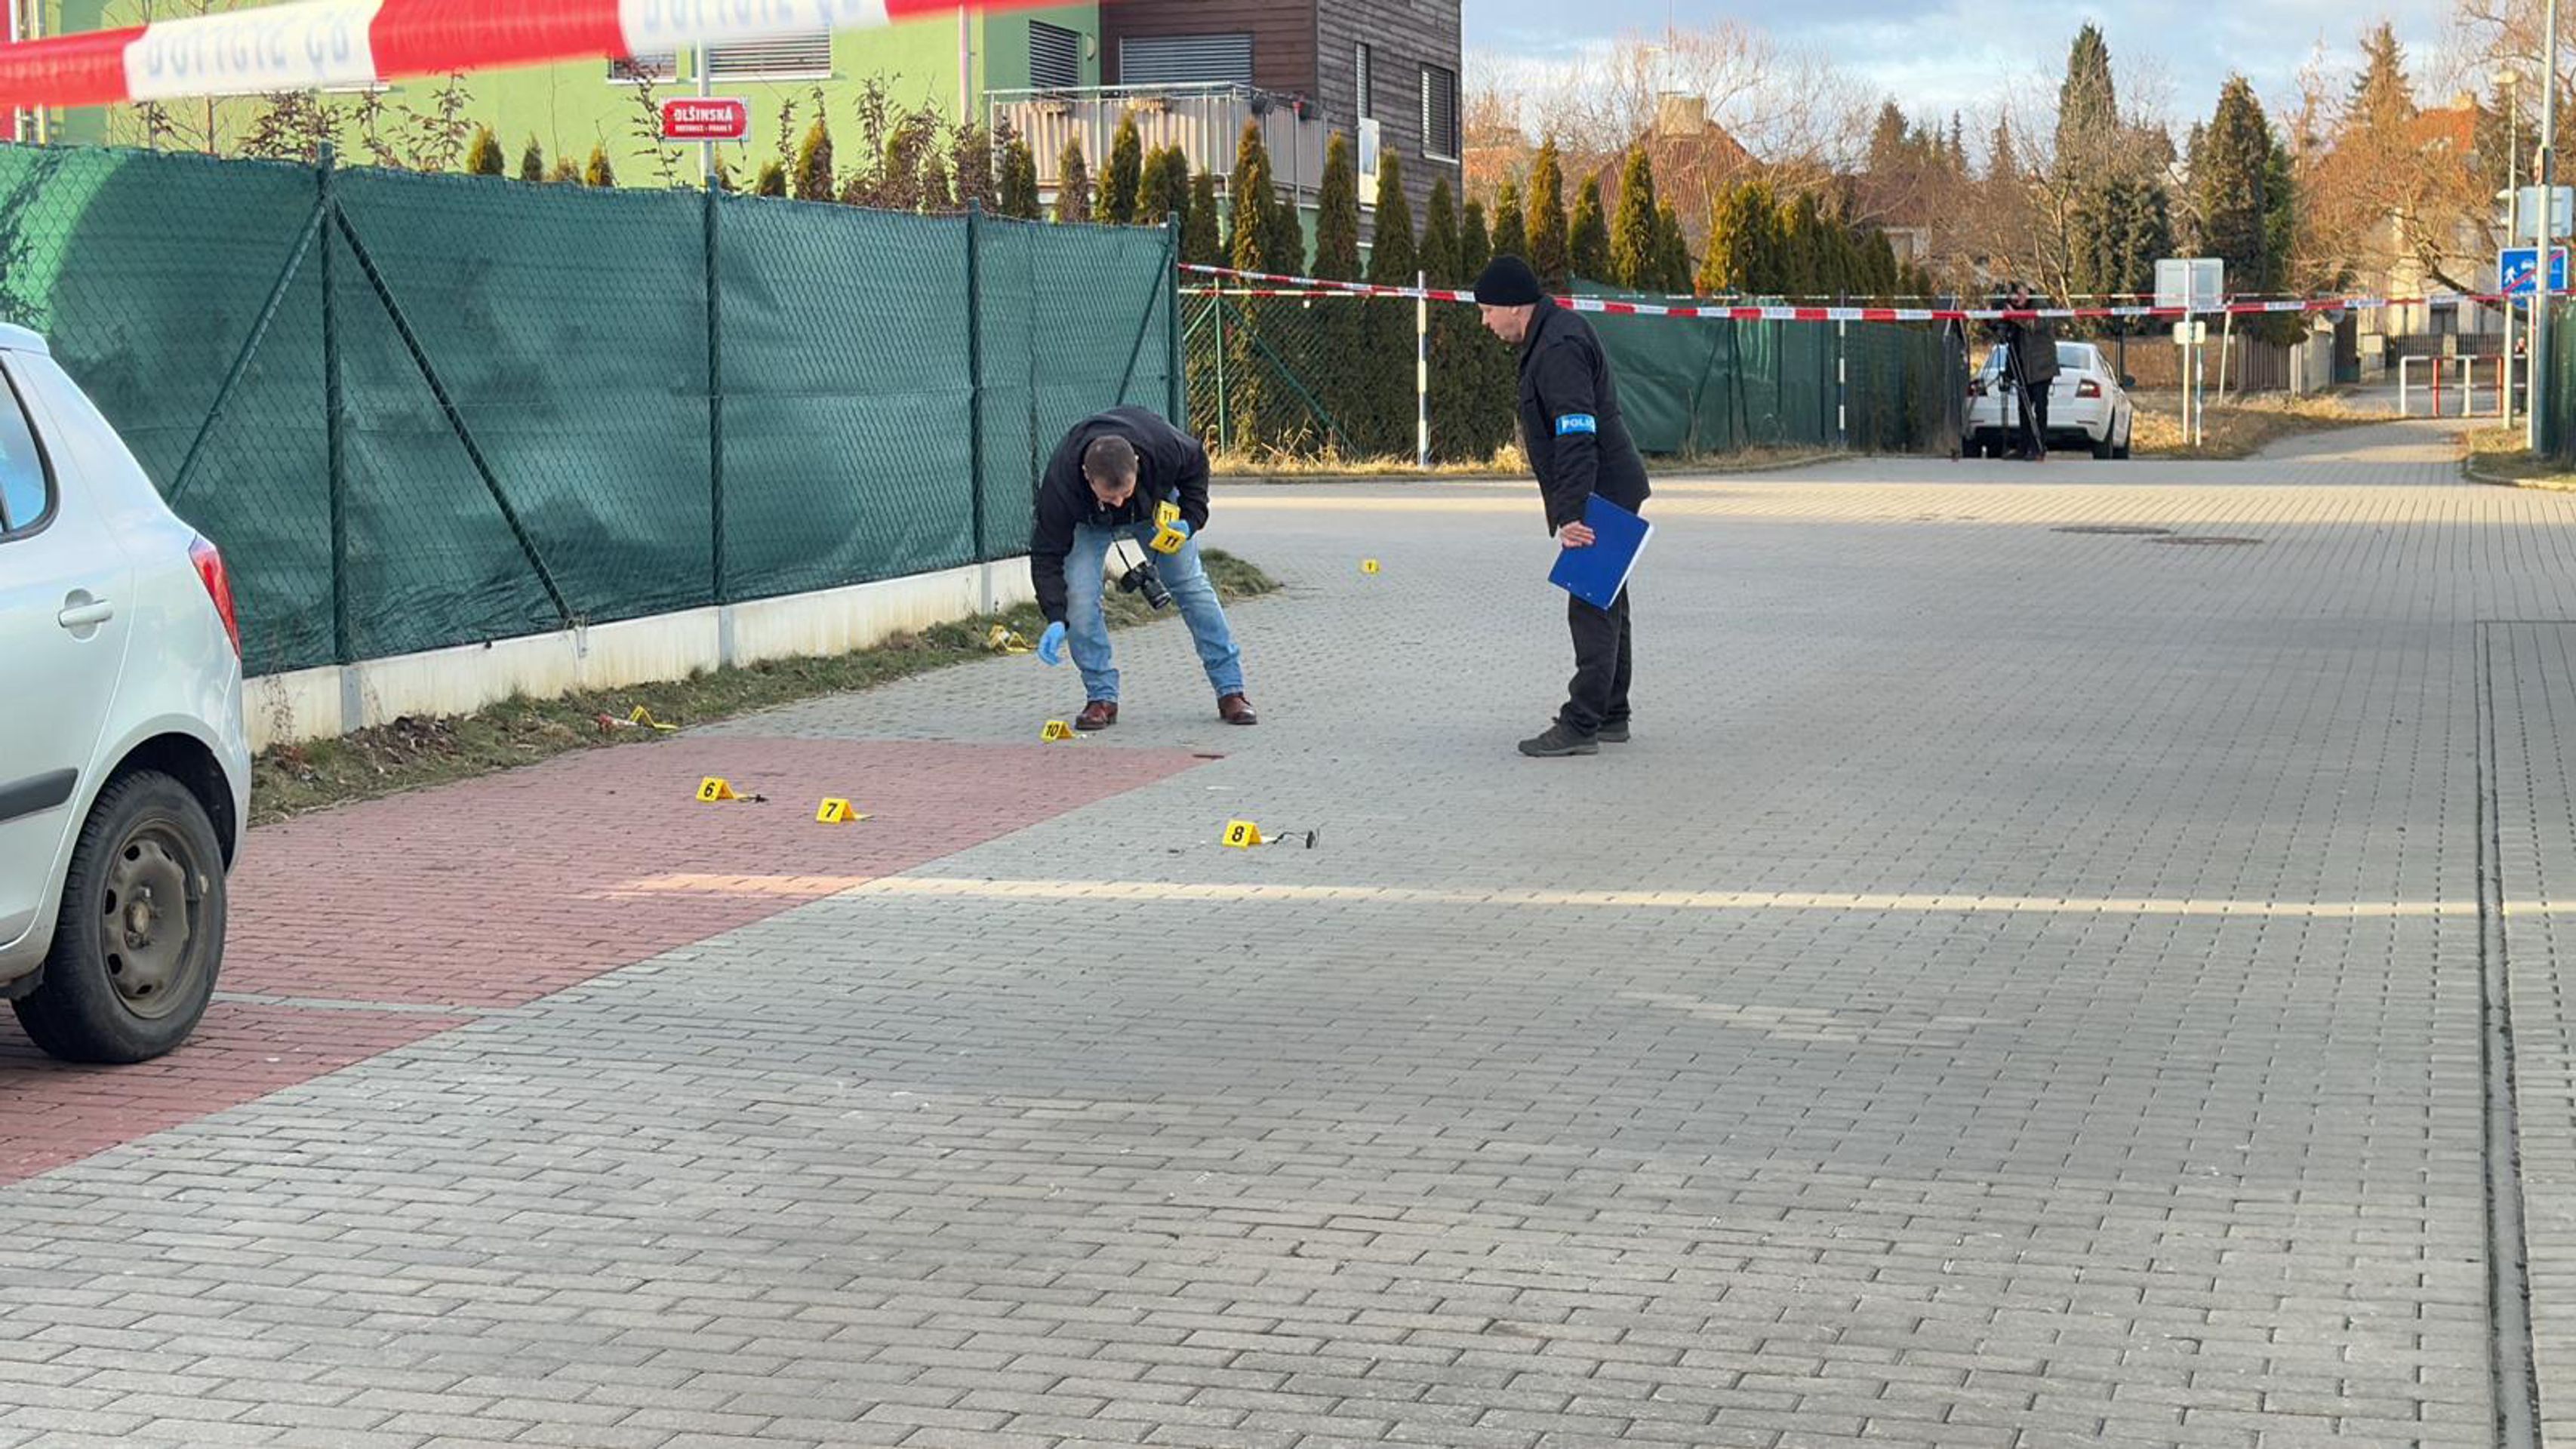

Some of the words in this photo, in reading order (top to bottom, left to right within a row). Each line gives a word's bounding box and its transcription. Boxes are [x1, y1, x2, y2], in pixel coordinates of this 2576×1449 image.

[674, 105, 733, 122] OLŠINSKÁ
[1045, 723, 1060, 737] 10
[703, 782, 716, 798] 6
[826, 801, 838, 818] 7
[1232, 826, 1245, 843] 8
